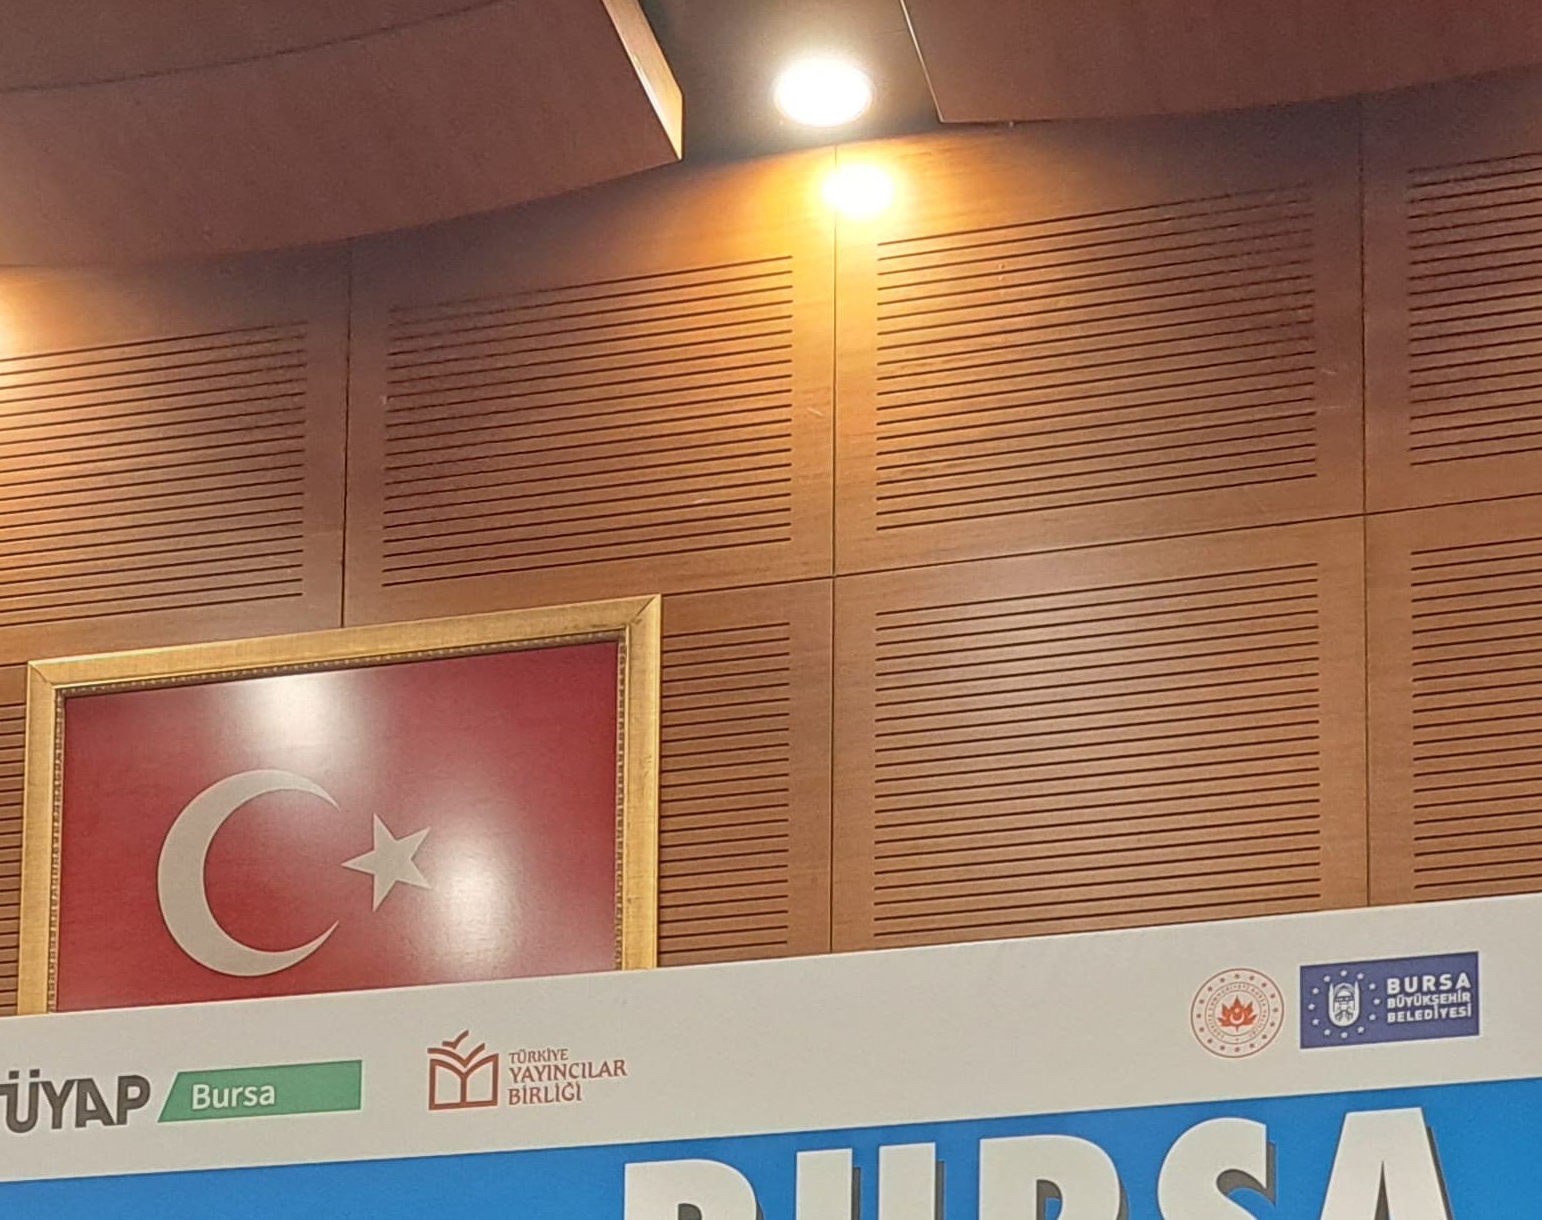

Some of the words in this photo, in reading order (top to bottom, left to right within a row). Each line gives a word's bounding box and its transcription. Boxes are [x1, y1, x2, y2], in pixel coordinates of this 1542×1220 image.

[1386, 971, 1472, 995] BURSA
[1386, 1002, 1473, 1024] BELEDİYESİ
[508, 1047, 569, 1065] TÜRKİYE
[508, 1059, 628, 1084] YAYINCILAR
[192, 1083, 276, 1110] Bursa
[509, 1082, 583, 1106] BİRLİĞİ
